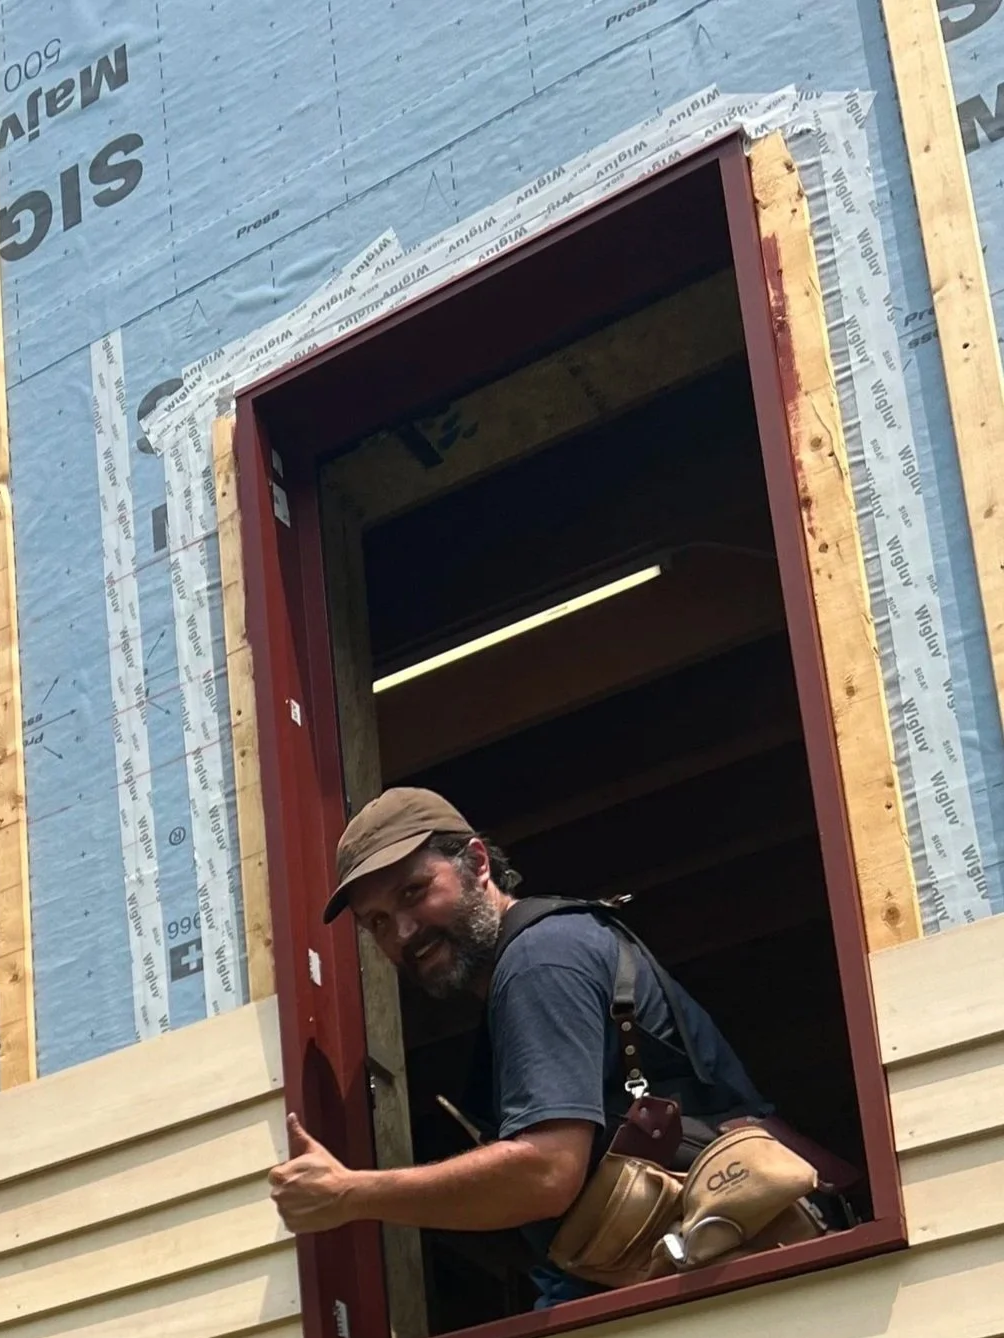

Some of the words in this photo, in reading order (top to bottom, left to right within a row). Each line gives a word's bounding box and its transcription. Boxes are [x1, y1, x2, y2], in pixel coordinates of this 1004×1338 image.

[4, 38, 61, 92] 500
[667, 87, 721, 128] Wigluv
[596, 139, 649, 180] Wigluv
[515, 165, 567, 205] Wigluv
[831, 166, 857, 215] Wigluv
[236, 209, 280, 239] Press
[447, 215, 498, 253] Wigluv
[477, 225, 529, 263] Wigluv
[349, 237, 392, 281] Wigluv
[856, 227, 882, 277] Wigluv
[310, 284, 357, 319] Wigluv
[382, 263, 431, 300] Wigluv
[248, 328, 294, 363] Wigluv
[847, 314, 871, 365] Wigluv
[182, 348, 226, 380] Wigluv
[163, 373, 204, 414] Wigluv
[870, 378, 898, 430] Wigluv
[187, 414, 202, 454] Wigluv
[102, 446, 118, 488] Wigluv
[200, 464, 217, 508] Wigluv
[898, 443, 924, 497] Wigluv
[116, 499, 132, 541] Wigluv
[169, 557, 186, 601] Wigluv
[886, 534, 914, 589] Wigluv
[105, 570, 121, 614] Wigluv
[119, 627, 135, 670] Wigluv
[185, 613, 203, 658] Wigluv
[914, 603, 943, 659] Wigluv
[201, 669, 220, 715] Wigluv
[901, 696, 930, 754] Wigluv
[122, 757, 139, 802] Wigluv
[192, 746, 210, 792] Wigluv
[930, 769, 960, 827] Wigluv
[137, 815, 156, 861] Wigluv
[207, 803, 229, 852] Wigluv
[961, 842, 991, 901] Wigluv
[126, 891, 144, 939] Wigluv
[198, 883, 216, 931] Wigluv
[142, 951, 161, 999] Wigluv
[214, 944, 234, 994] Wigluv
[706, 1160, 746, 1192] CLC
